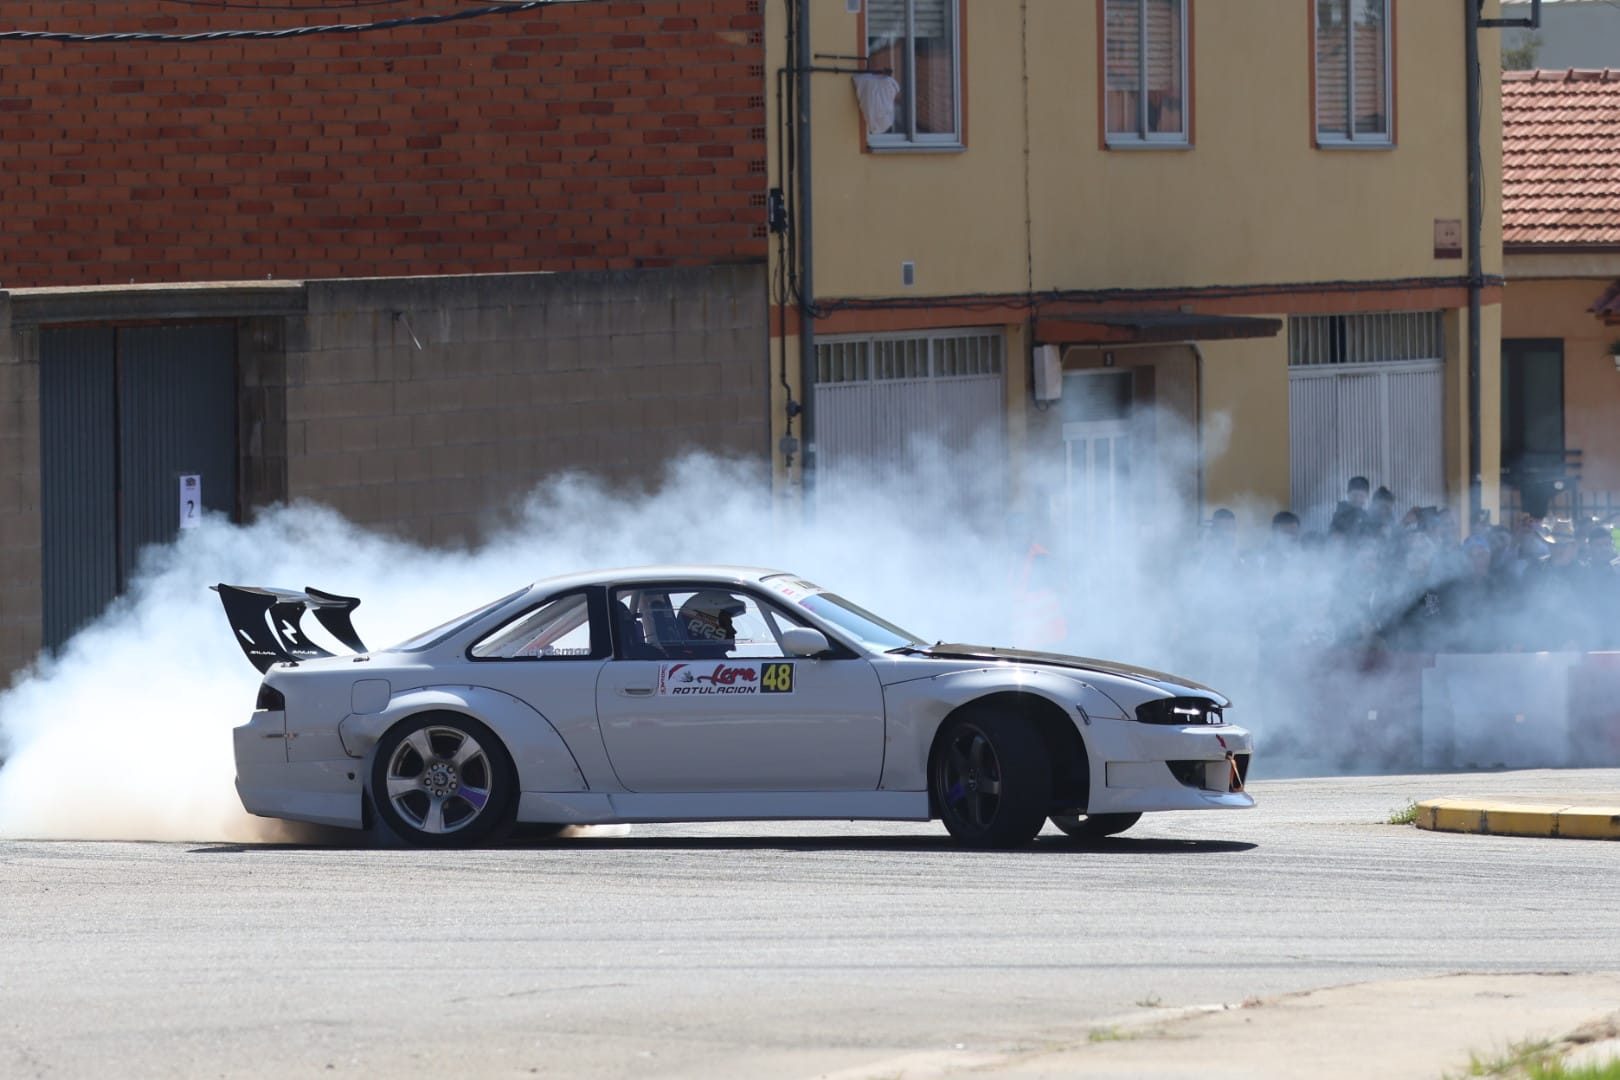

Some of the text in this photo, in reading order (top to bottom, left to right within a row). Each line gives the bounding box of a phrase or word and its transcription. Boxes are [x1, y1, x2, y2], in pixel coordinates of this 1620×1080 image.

[187, 500, 194, 518] 2
[688, 619, 727, 640] RRS
[762, 664, 790, 691] 48
[672, 686, 758, 694] ROTULACION
